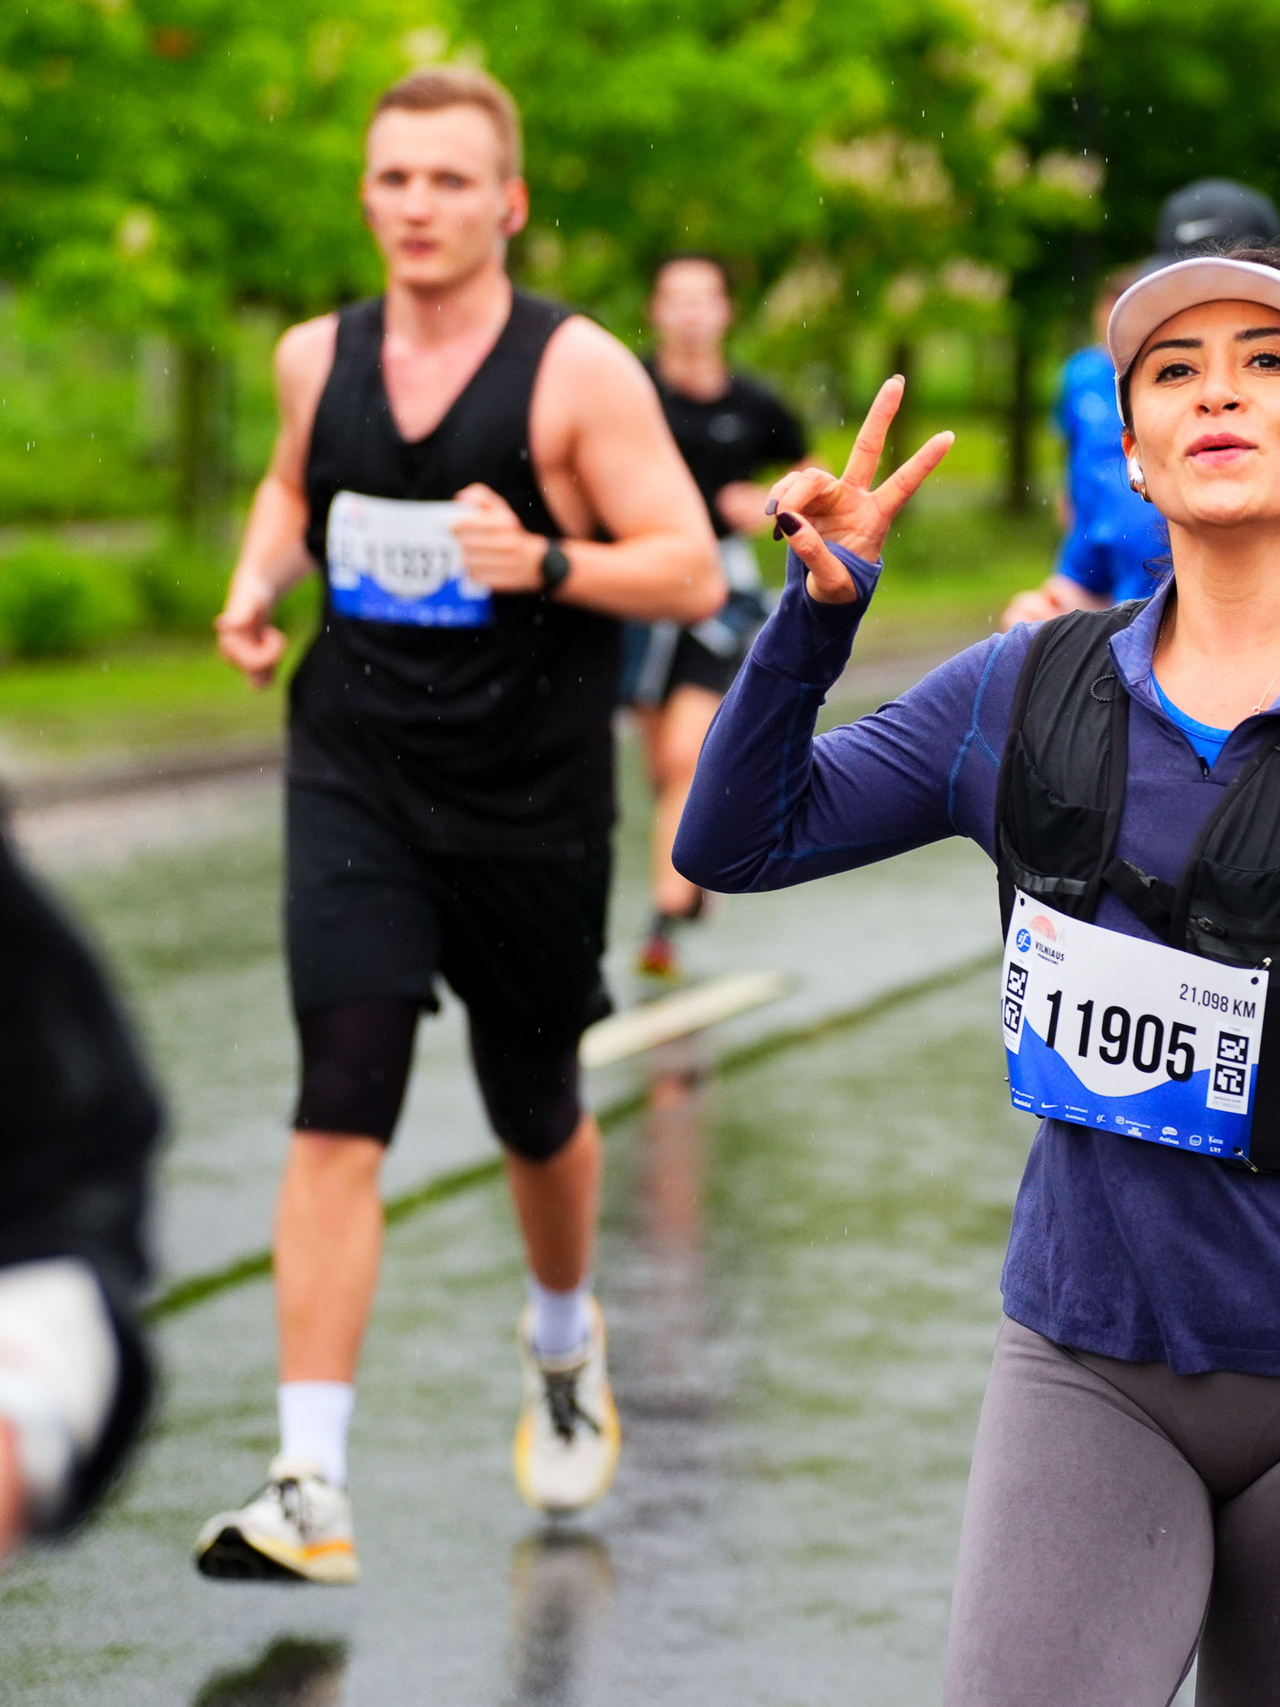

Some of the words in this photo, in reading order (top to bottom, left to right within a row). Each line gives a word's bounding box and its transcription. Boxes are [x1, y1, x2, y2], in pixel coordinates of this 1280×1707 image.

[1035, 940, 1065, 962] VILNIAUS
[1179, 983, 1229, 1013] 21,098
[1232, 998, 1256, 1019] KM
[1045, 989, 1197, 1082] 11905
